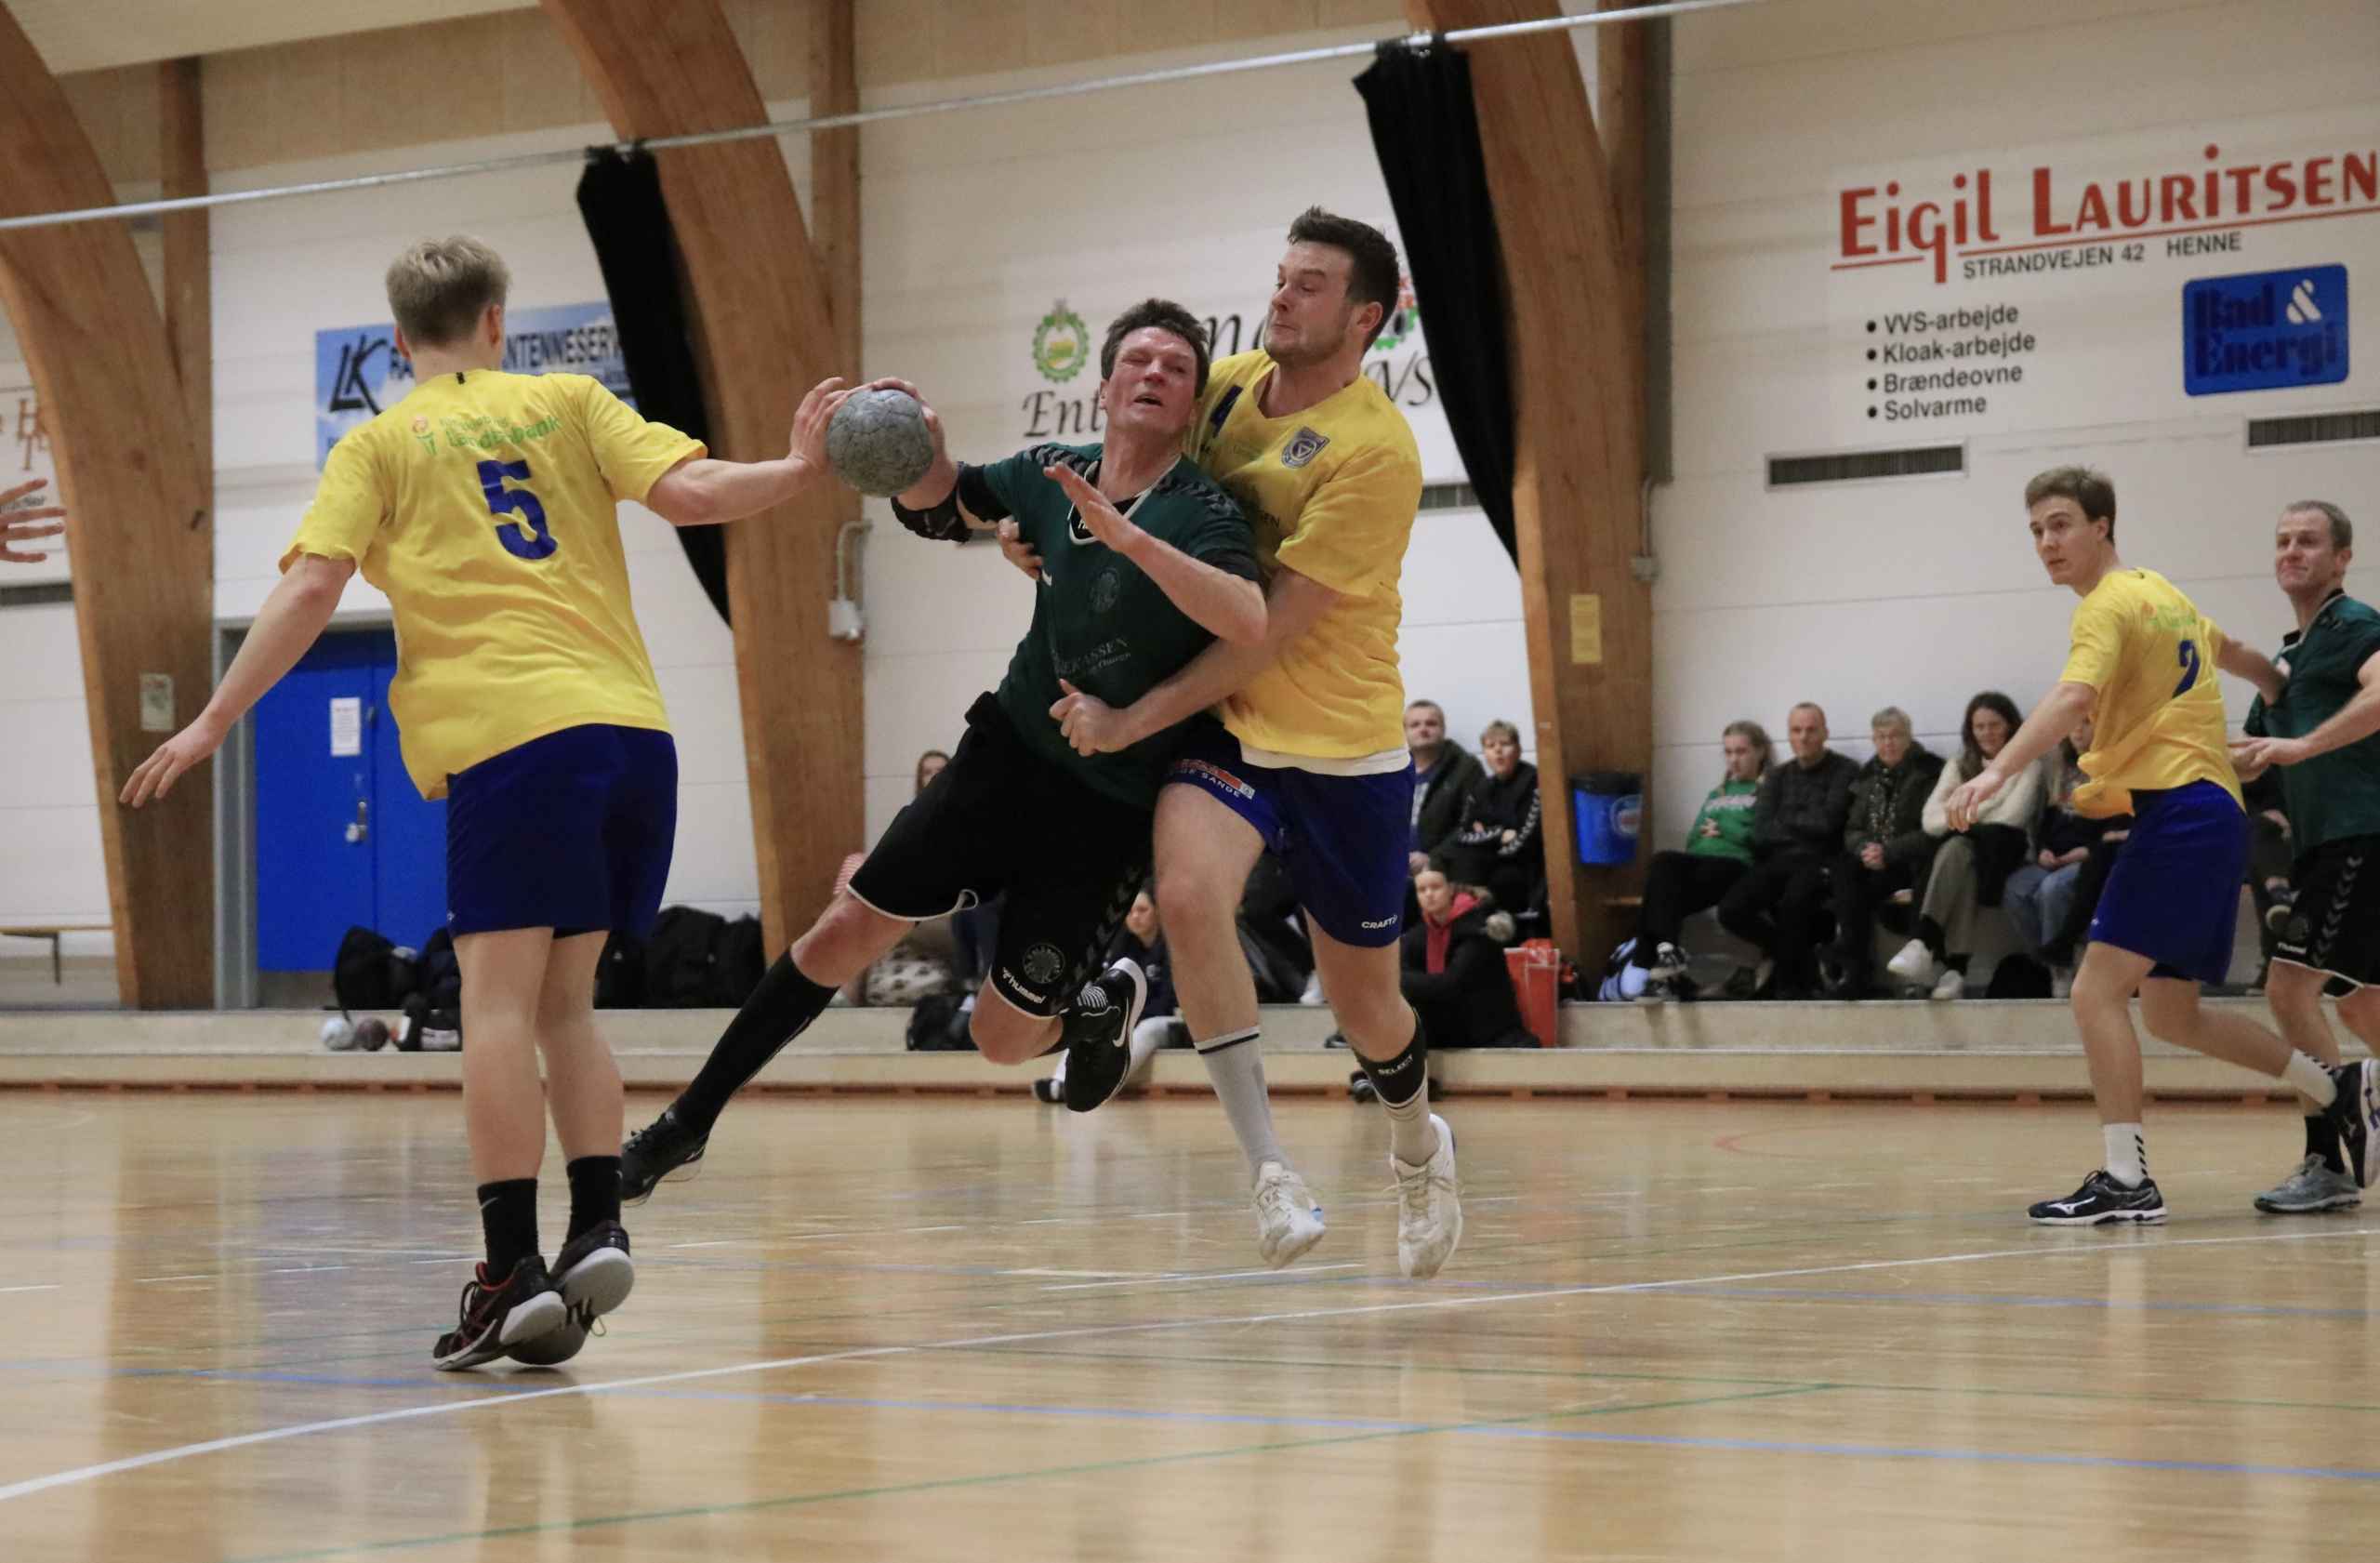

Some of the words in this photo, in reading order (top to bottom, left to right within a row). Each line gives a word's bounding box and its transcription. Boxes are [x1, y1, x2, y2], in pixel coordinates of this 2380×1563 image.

[1840, 168, 2001, 284] Eigil
[1963, 246, 2113, 280] STRANDVEJEN
[2121, 244, 2145, 263] 42
[2166, 232, 2241, 258] HENNE
[2286, 278, 2322, 325] &
[1884, 304, 2019, 335] VVS-arbejde
[1883, 331, 2036, 364] Kloak-arbejde
[1884, 365, 2024, 394] Brændeovne
[1884, 396, 1988, 421] Solvarme
[476, 459, 559, 560] 5
[1361, 915, 1396, 930] CRAFT
